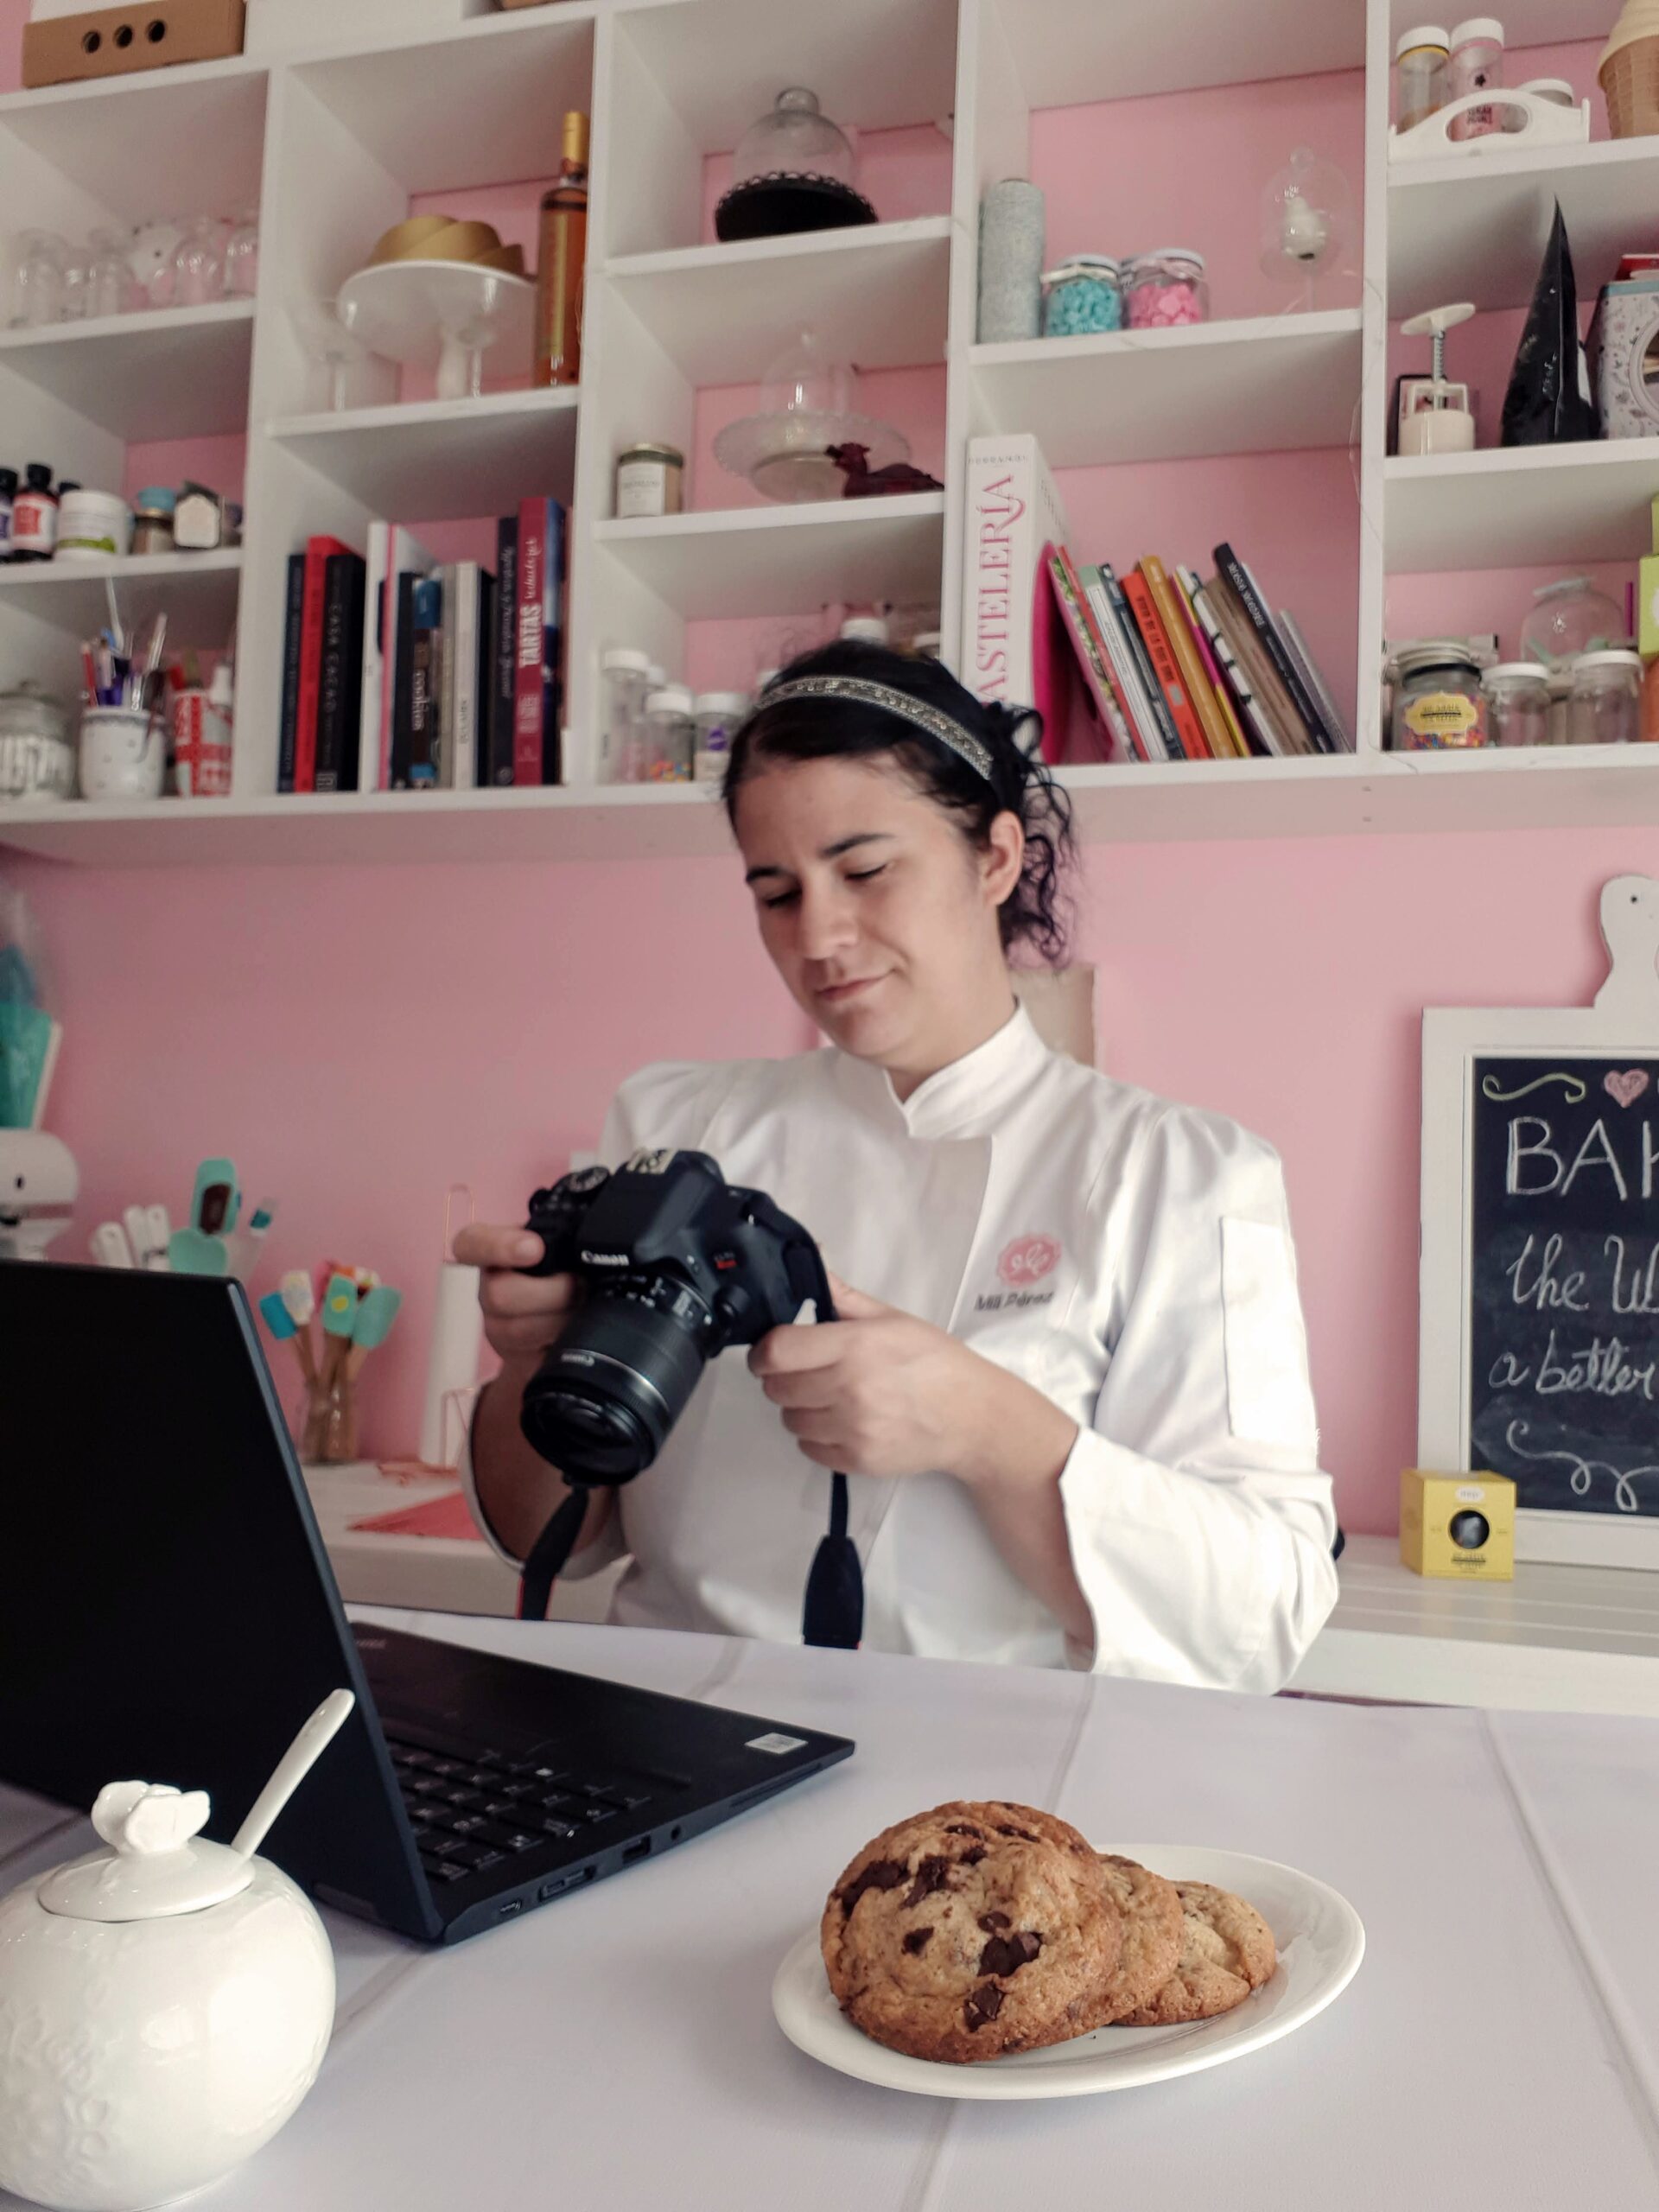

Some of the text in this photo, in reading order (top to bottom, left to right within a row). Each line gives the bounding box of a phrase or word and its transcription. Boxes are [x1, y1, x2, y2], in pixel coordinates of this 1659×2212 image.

[976, 474, 1027, 709] ASTELERÍA
[518, 602, 543, 669] TARTAS
[581, 1249, 630, 1267] Canon
[1506, 1233, 1590, 1311] the
[1488, 1328, 1656, 1401] a better
